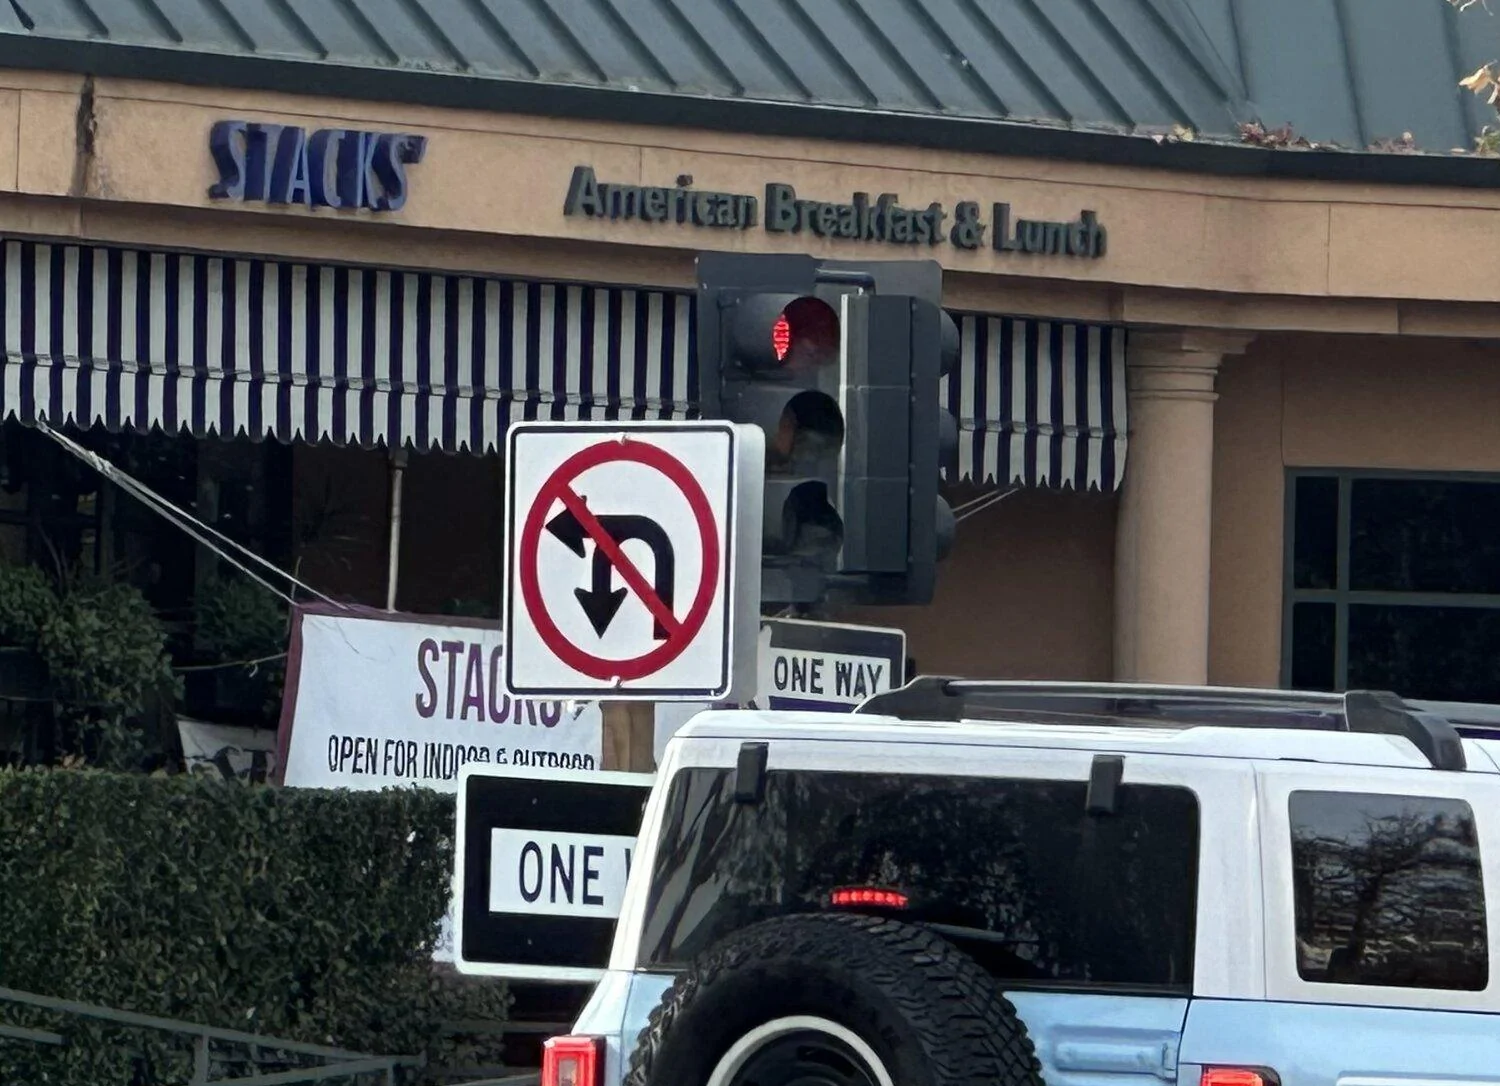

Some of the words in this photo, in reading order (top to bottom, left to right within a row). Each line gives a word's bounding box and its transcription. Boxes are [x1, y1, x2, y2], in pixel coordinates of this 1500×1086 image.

[563, 165, 759, 231] American
[765, 182, 947, 248] Breakfast
[951, 200, 986, 250] &
[993, 202, 1108, 259] Lunch
[773, 655, 825, 695] ONE
[834, 660, 883, 698] WAY
[328, 734, 378, 776] OPEN
[383, 738, 417, 778] FOR
[518, 841, 605, 906] ONE
